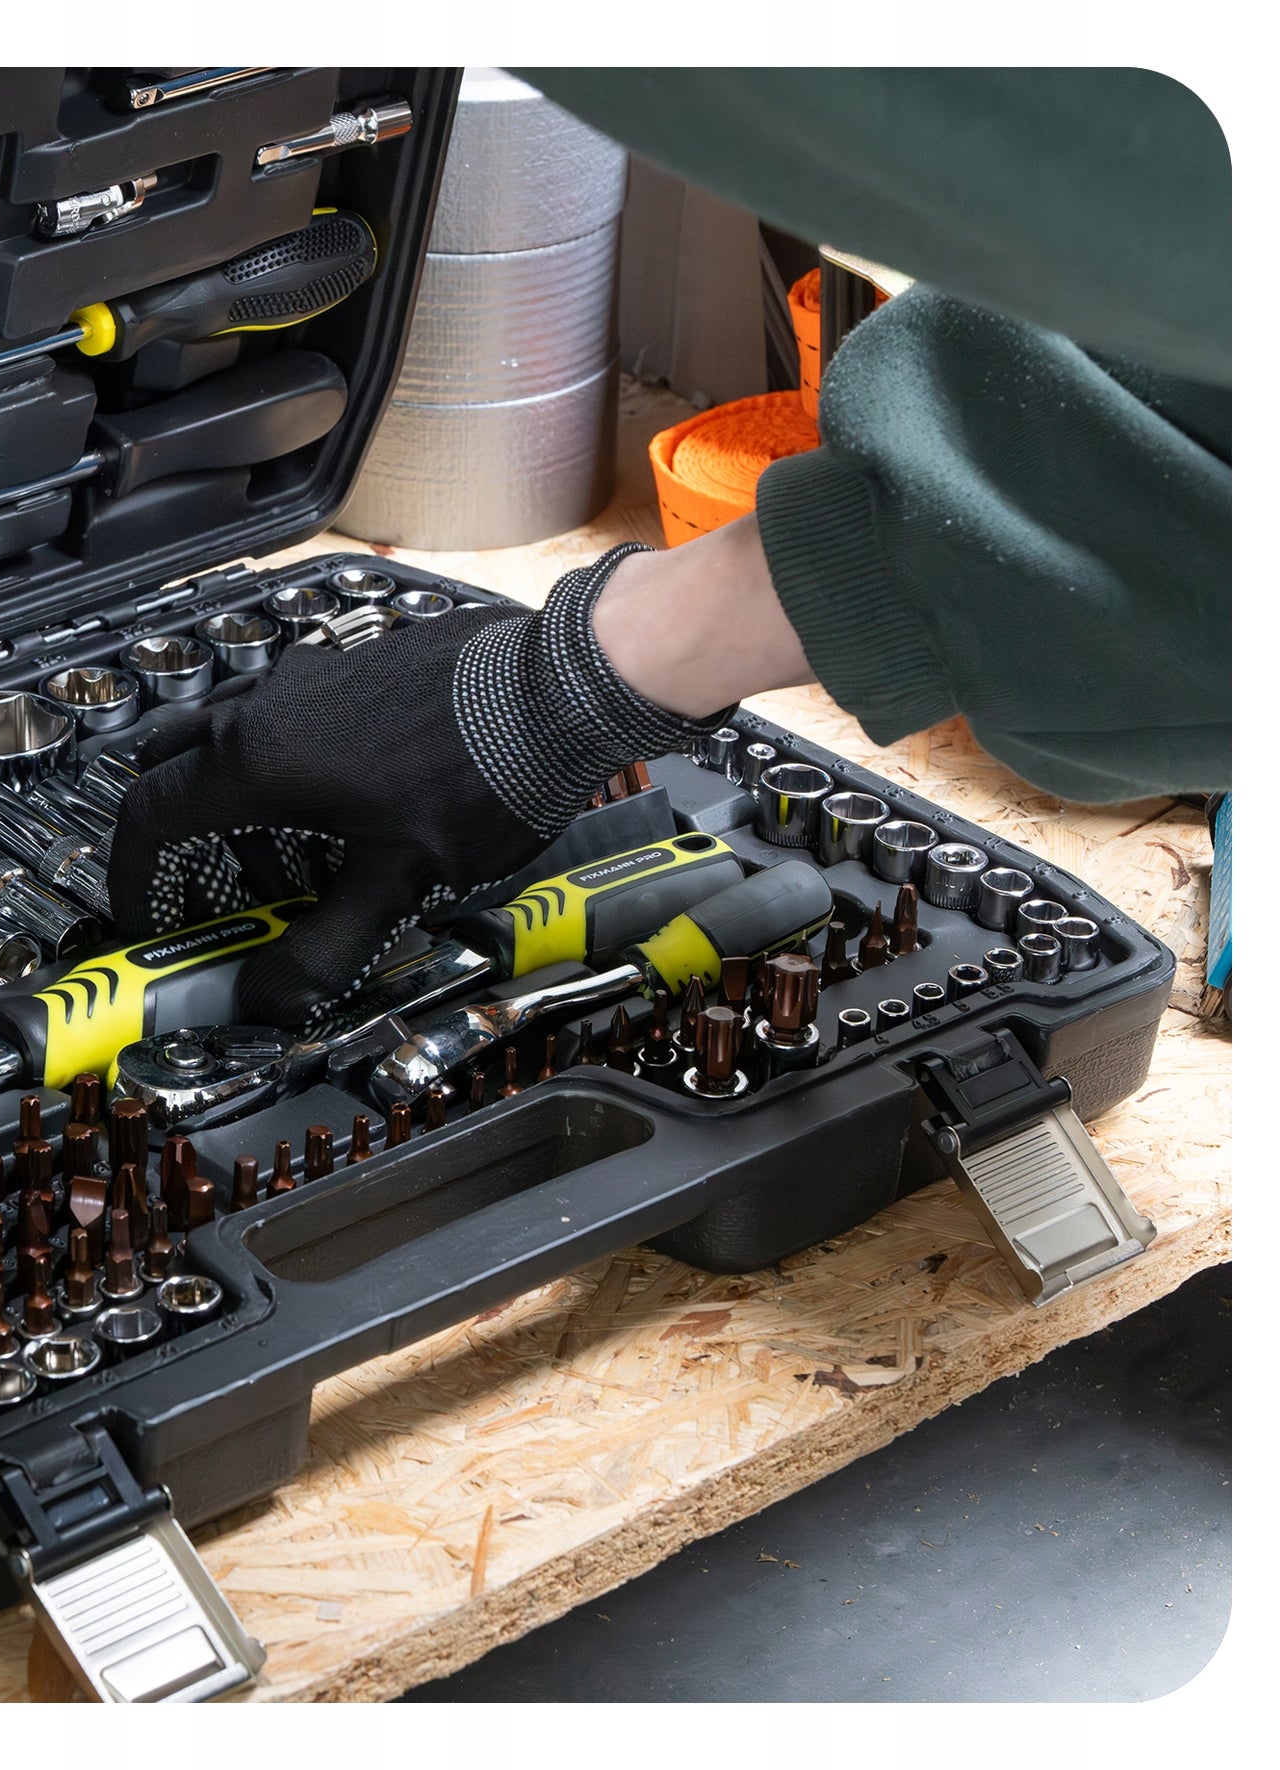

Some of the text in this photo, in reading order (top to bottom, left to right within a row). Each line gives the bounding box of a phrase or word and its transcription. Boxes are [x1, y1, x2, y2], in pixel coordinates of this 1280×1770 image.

[579, 851, 662, 882] FIXMANN PRO
[142, 922, 256, 962] FIXMANN PRO
